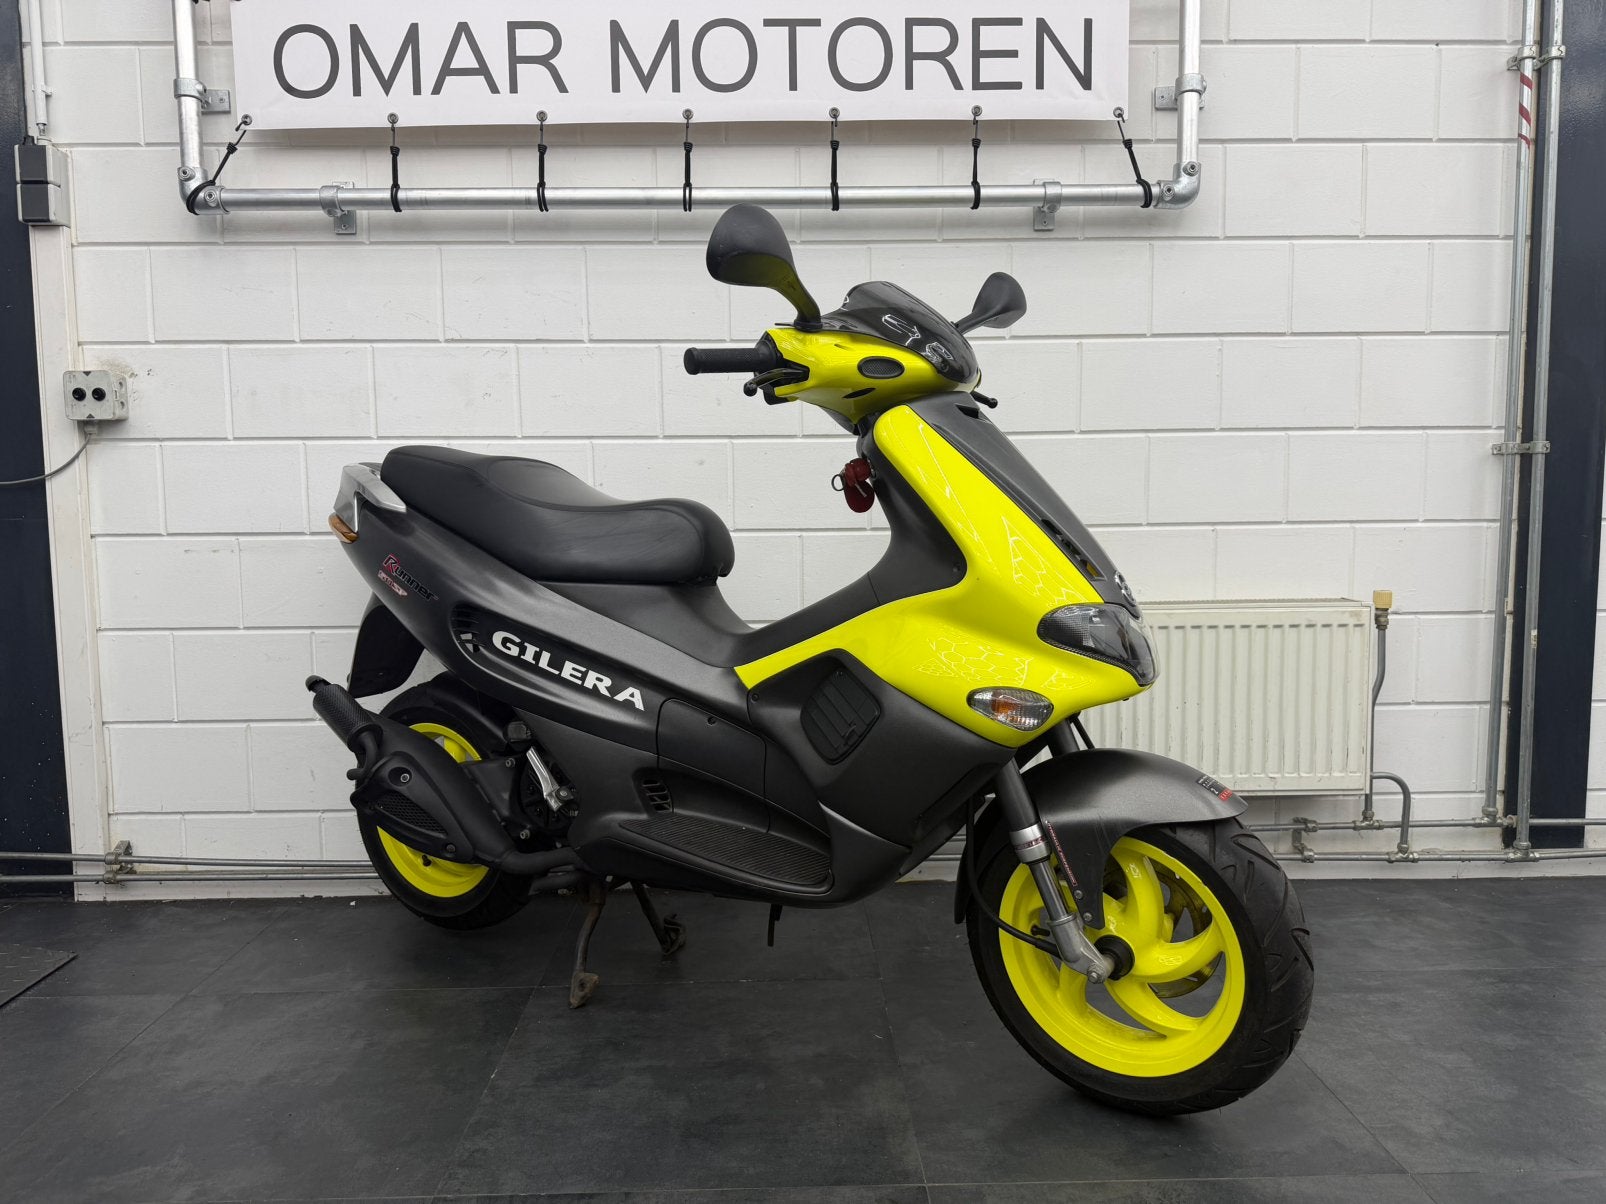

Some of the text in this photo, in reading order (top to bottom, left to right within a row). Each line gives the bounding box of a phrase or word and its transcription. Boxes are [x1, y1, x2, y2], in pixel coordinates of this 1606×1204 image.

[273, 16, 1093, 100] OMAR MOTOREN
[382, 553, 440, 602] Runner
[492, 630, 645, 711] GILERA
